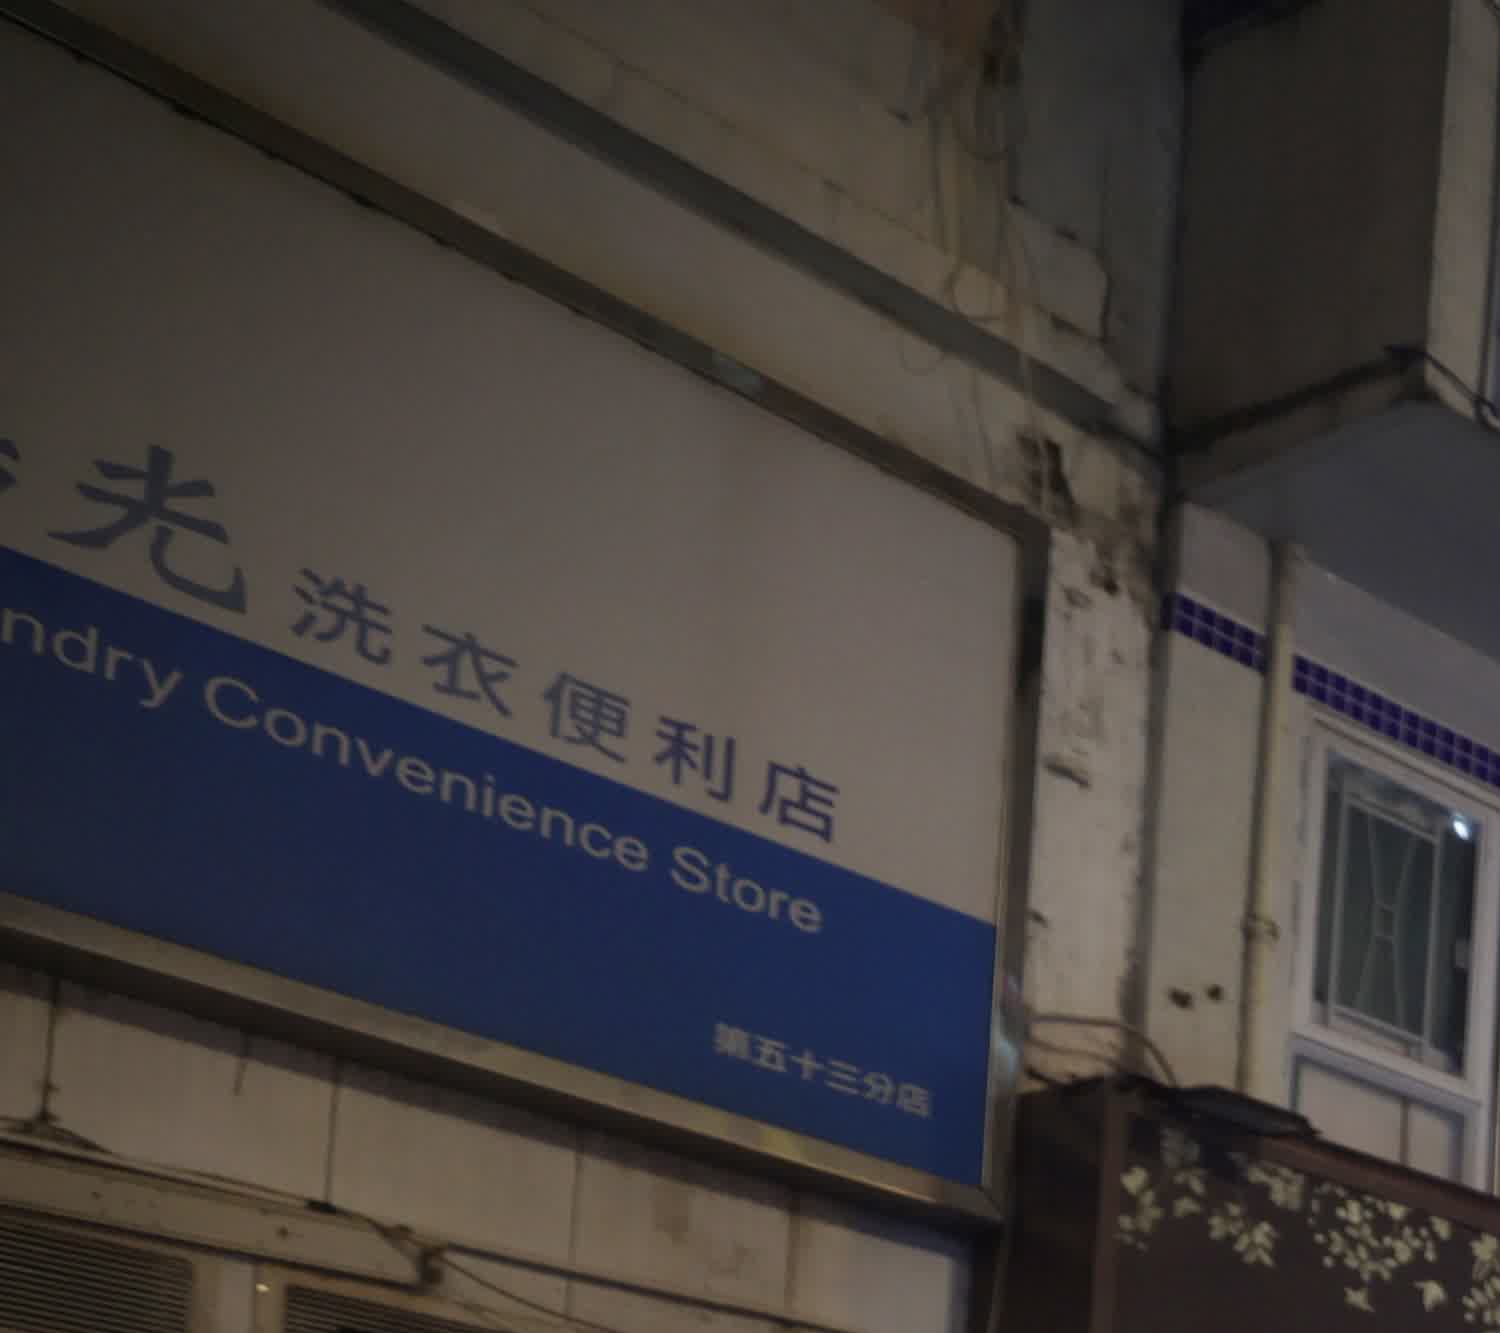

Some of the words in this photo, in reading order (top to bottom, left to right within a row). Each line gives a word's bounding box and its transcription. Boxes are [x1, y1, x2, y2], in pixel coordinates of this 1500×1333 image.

[0, 438, 247, 616] 光
[291, 567, 841, 843] 洗衣便利店
[203, 674, 650, 873] Convenience
[670, 845, 823, 935] Store
[714, 1020, 933, 1121] 第五十三分店
